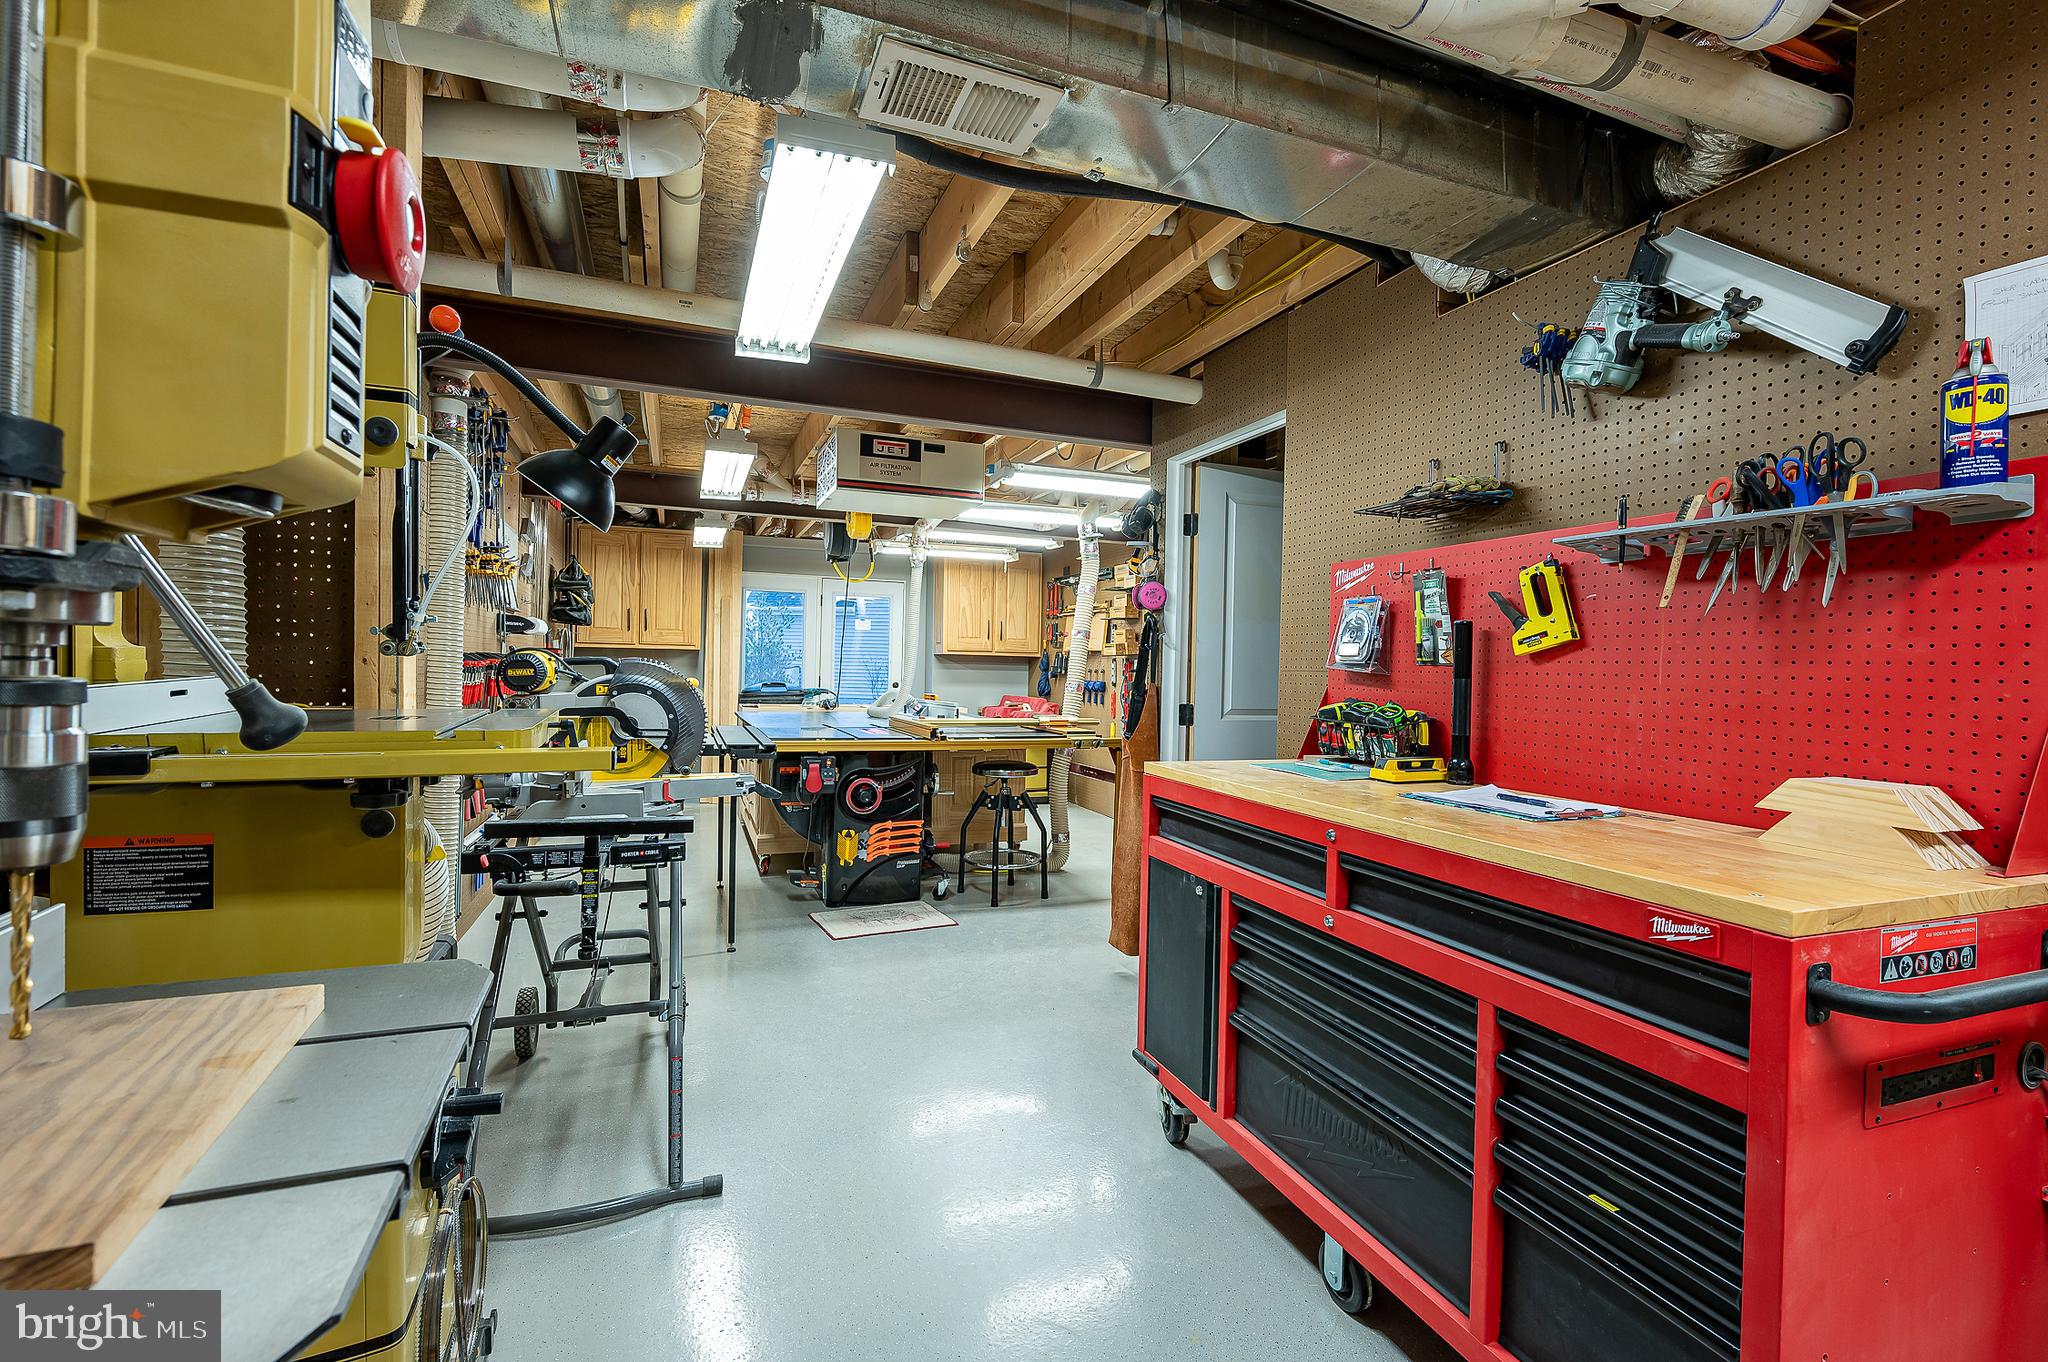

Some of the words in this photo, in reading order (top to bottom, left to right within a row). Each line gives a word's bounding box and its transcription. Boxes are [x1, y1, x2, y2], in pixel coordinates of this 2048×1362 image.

[1950, 388, 2005, 410] WD-40
[1974, 430, 1982, 440] 2
[877, 446, 906, 454] JET
[1334, 562, 1375, 588] Milwaukee
[1649, 916, 1711, 934] Milwaukee
